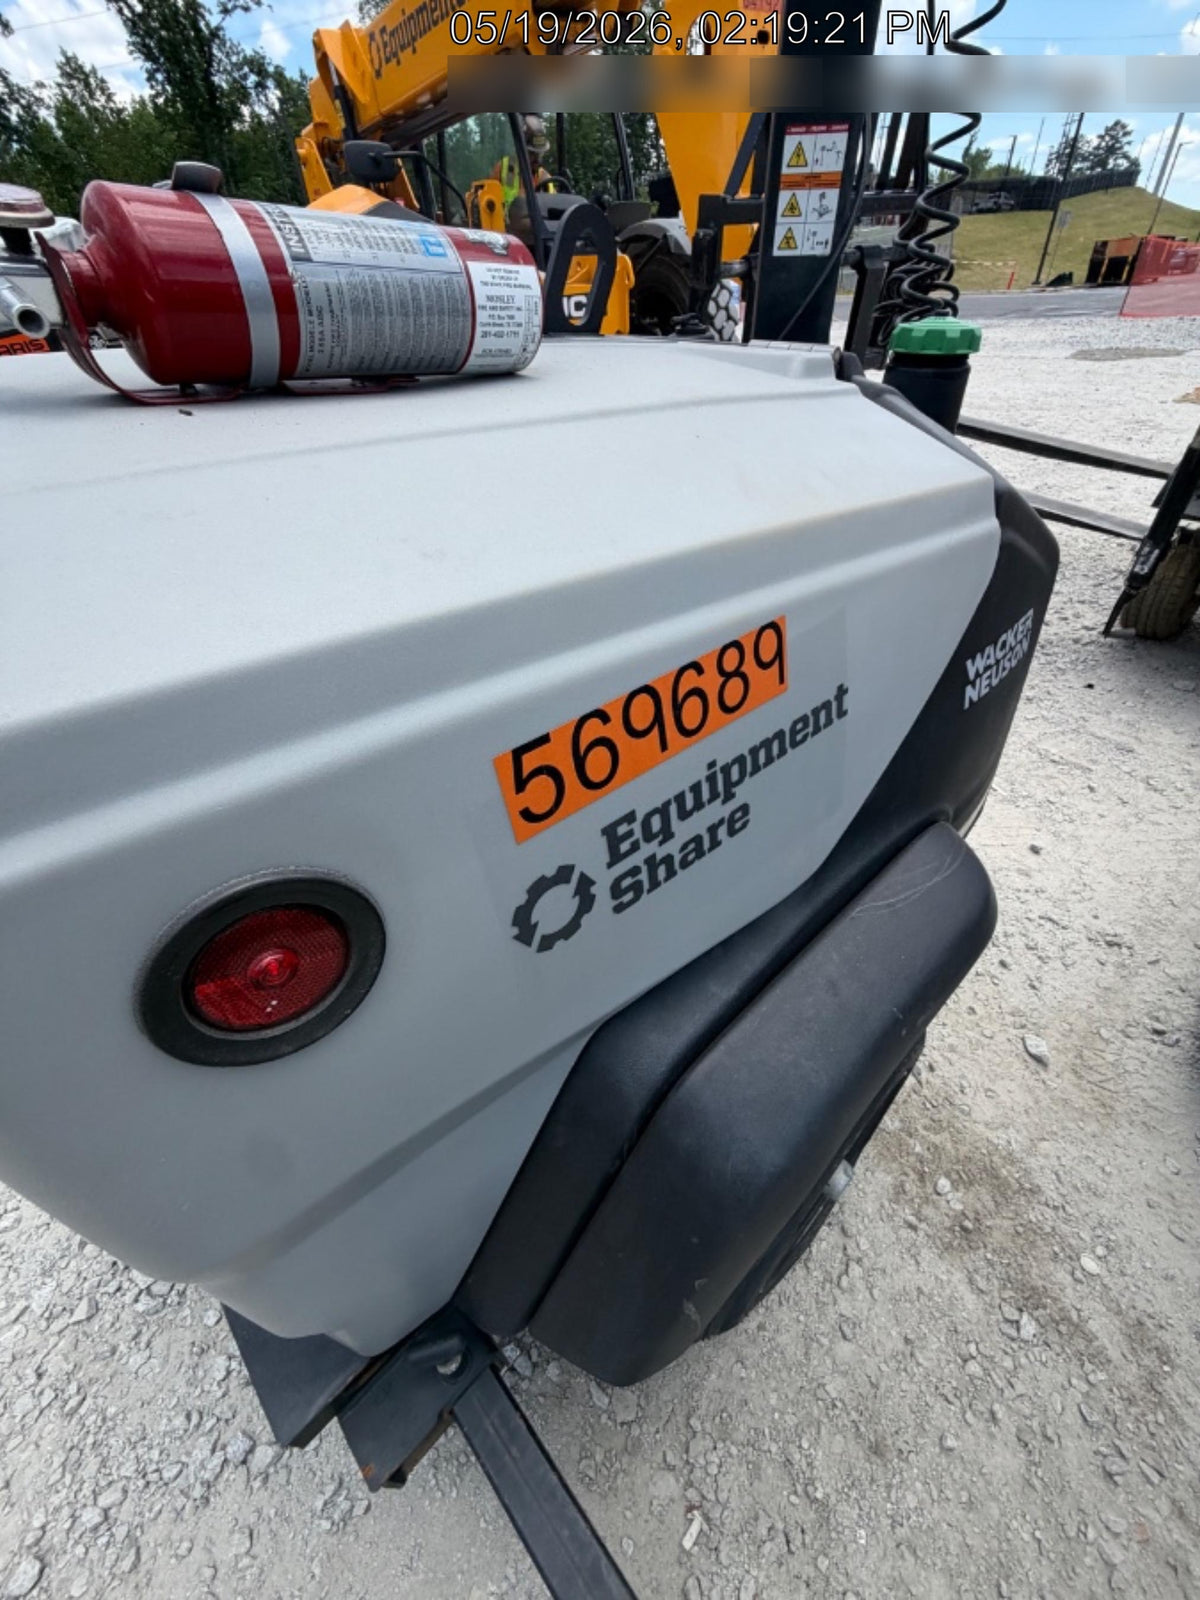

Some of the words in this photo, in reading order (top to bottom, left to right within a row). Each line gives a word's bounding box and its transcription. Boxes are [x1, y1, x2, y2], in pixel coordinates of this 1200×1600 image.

[963, 630, 1031, 710] NEUSON
[965, 607, 1034, 681] WACKER
[511, 620, 785, 824] 569689
[601, 682, 849, 869] Equipment
[609, 802, 750, 915] Share
